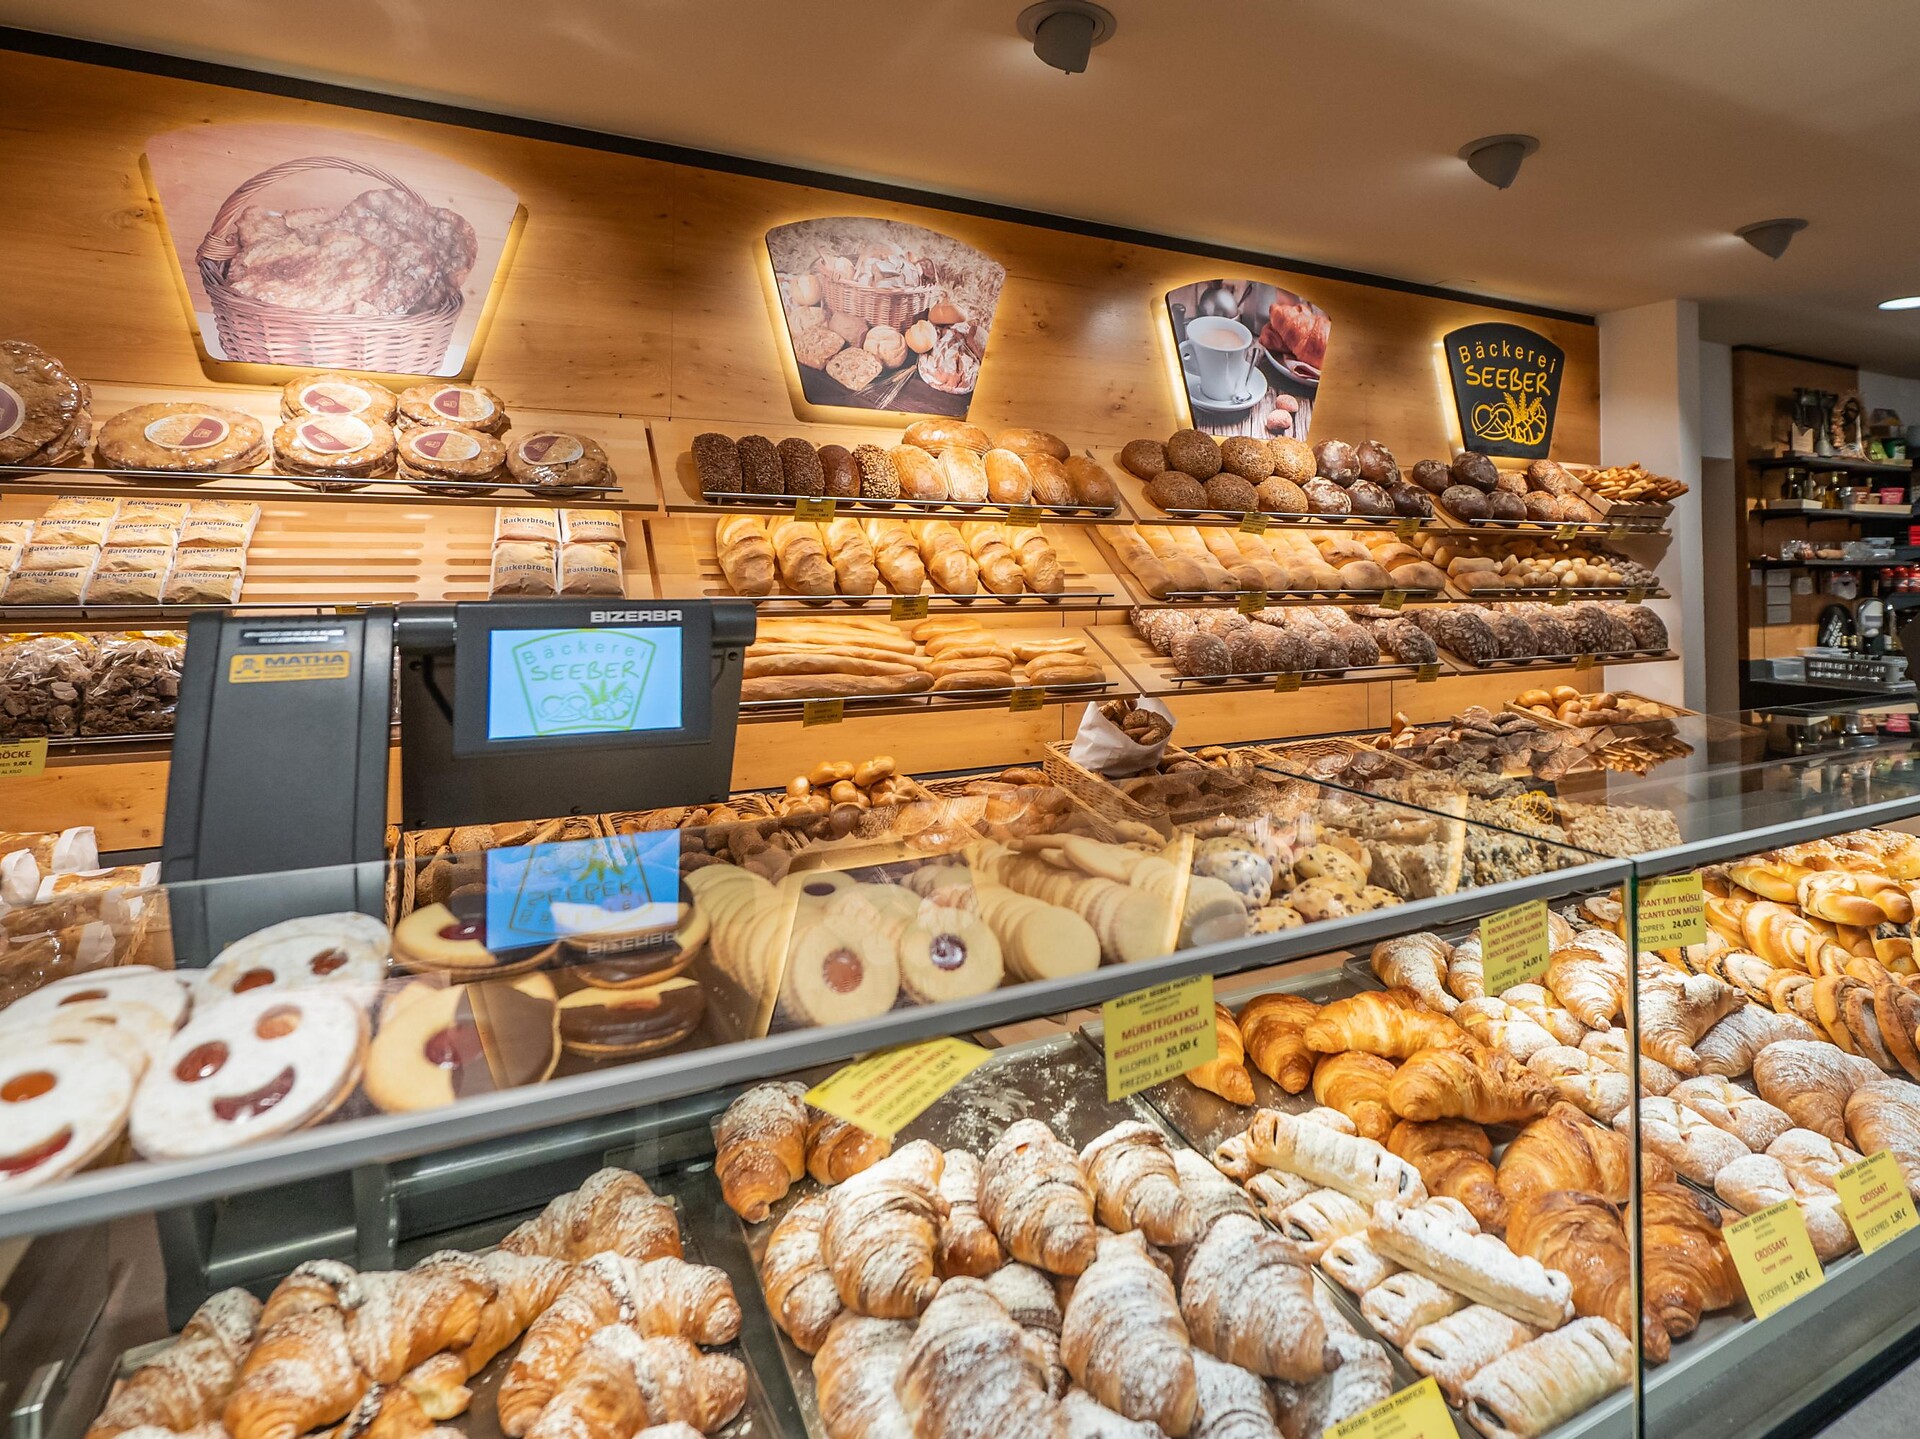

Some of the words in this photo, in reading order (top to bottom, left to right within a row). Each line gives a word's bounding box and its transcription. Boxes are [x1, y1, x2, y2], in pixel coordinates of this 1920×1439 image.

[1458, 340, 1556, 373] Bäckerei
[1465, 365, 1551, 396] SEEBER
[590, 609, 683, 623] BIZERBA
[264, 654, 344, 666] MATHA
[521, 640, 647, 666] Bäckerei
[530, 660, 640, 682] SEEBER
[1663, 896, 1676, 904] MIT
[1679, 892, 1699, 902] MÜSLI
[1683, 904, 1702, 913] MÜSLI
[1672, 919, 1691, 928] 24,00
[1122, 1005, 1199, 1039] MÜRBTEIGKEKSE
[1114, 1039, 1151, 1059] BISCOTTI
[1154, 1030, 1177, 1044] PASTA
[1180, 1019, 1208, 1034] FROLLA
[1119, 1052, 1158, 1074] KILOPREIS
[1166, 1040, 1190, 1058] 20,00
[1193, 1037, 1198, 1047] €
[1120, 1071, 1150, 1090] PREZZO
[1153, 1067, 1161, 1077] AL
[1165, 1059, 1182, 1072] KILO
[1859, 1183, 1888, 1204] CROISSANT
[1901, 1207, 1907, 1216] €
[1754, 1238, 1789, 1261] CROISSANT
[1757, 1280, 1789, 1303] STÜCKPREIS
[1790, 1270, 1805, 1285] 1,90
[1804, 1267, 1811, 1277] €
